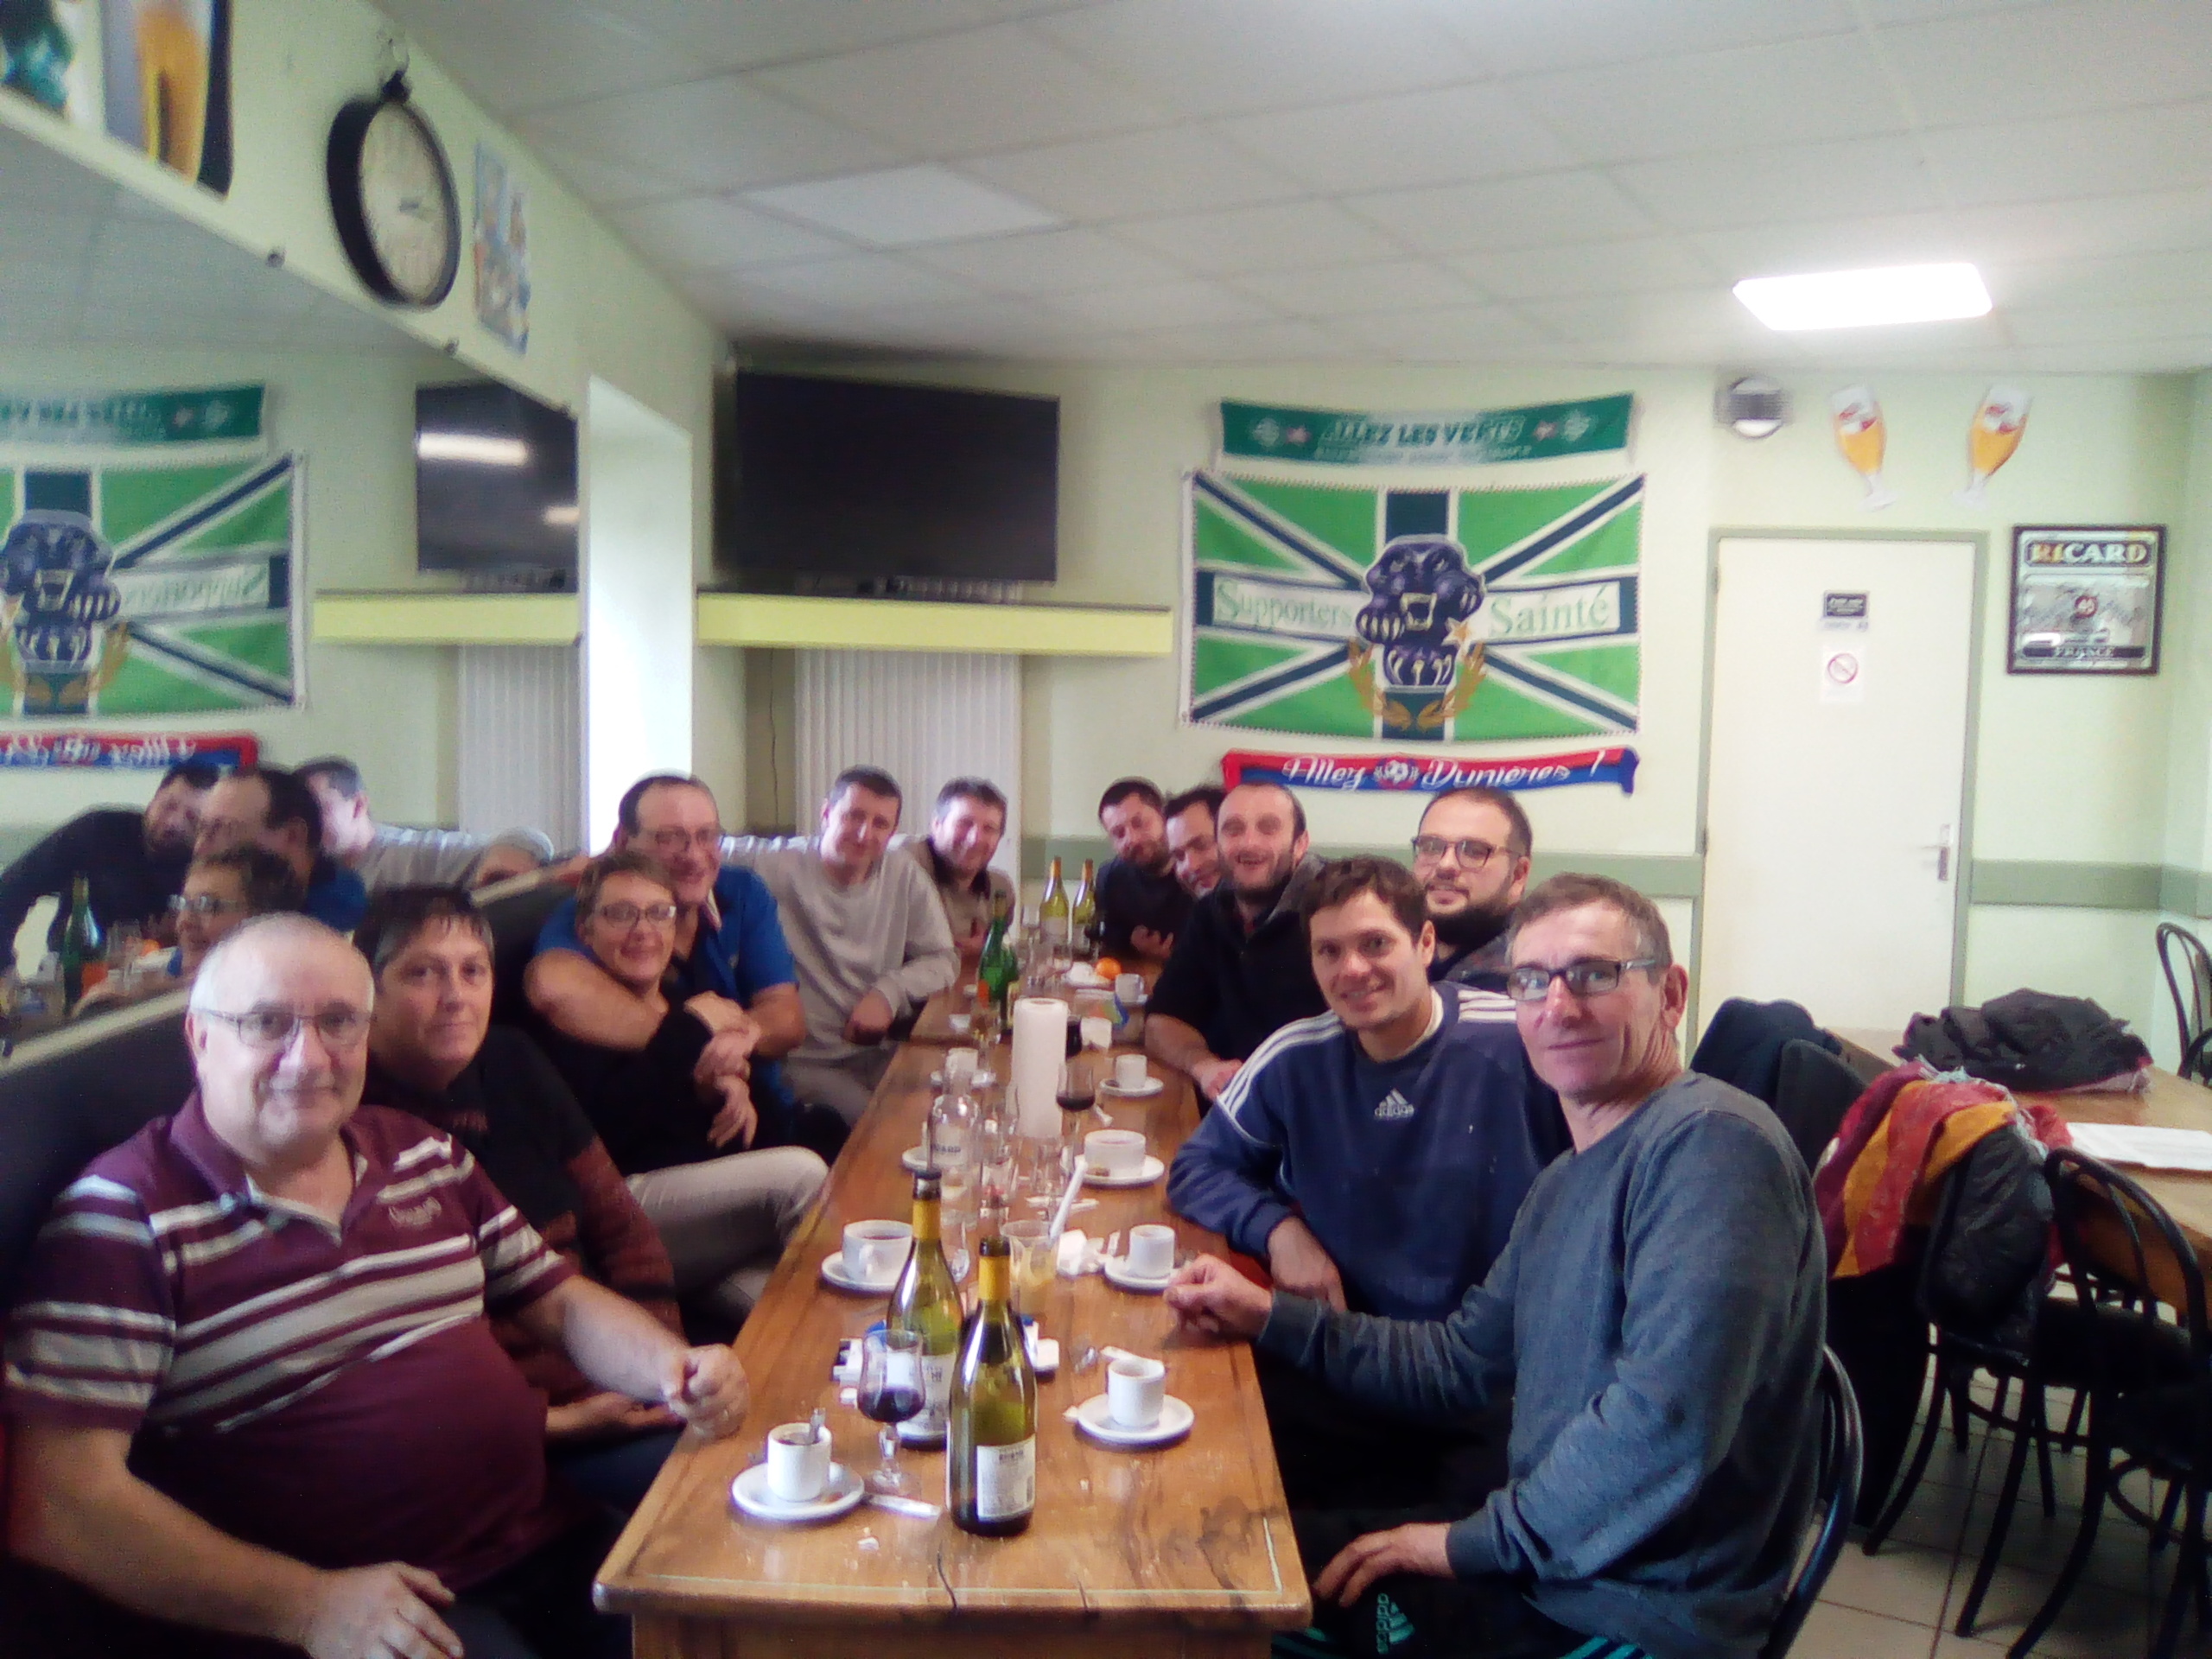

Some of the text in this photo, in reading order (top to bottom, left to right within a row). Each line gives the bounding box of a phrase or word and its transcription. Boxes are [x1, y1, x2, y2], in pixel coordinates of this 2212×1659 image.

[2031, 543, 2147, 563] RICARD
[1215, 579, 1609, 636] Supporters Sainté
[1374, 1102, 1414, 1117] adidas
